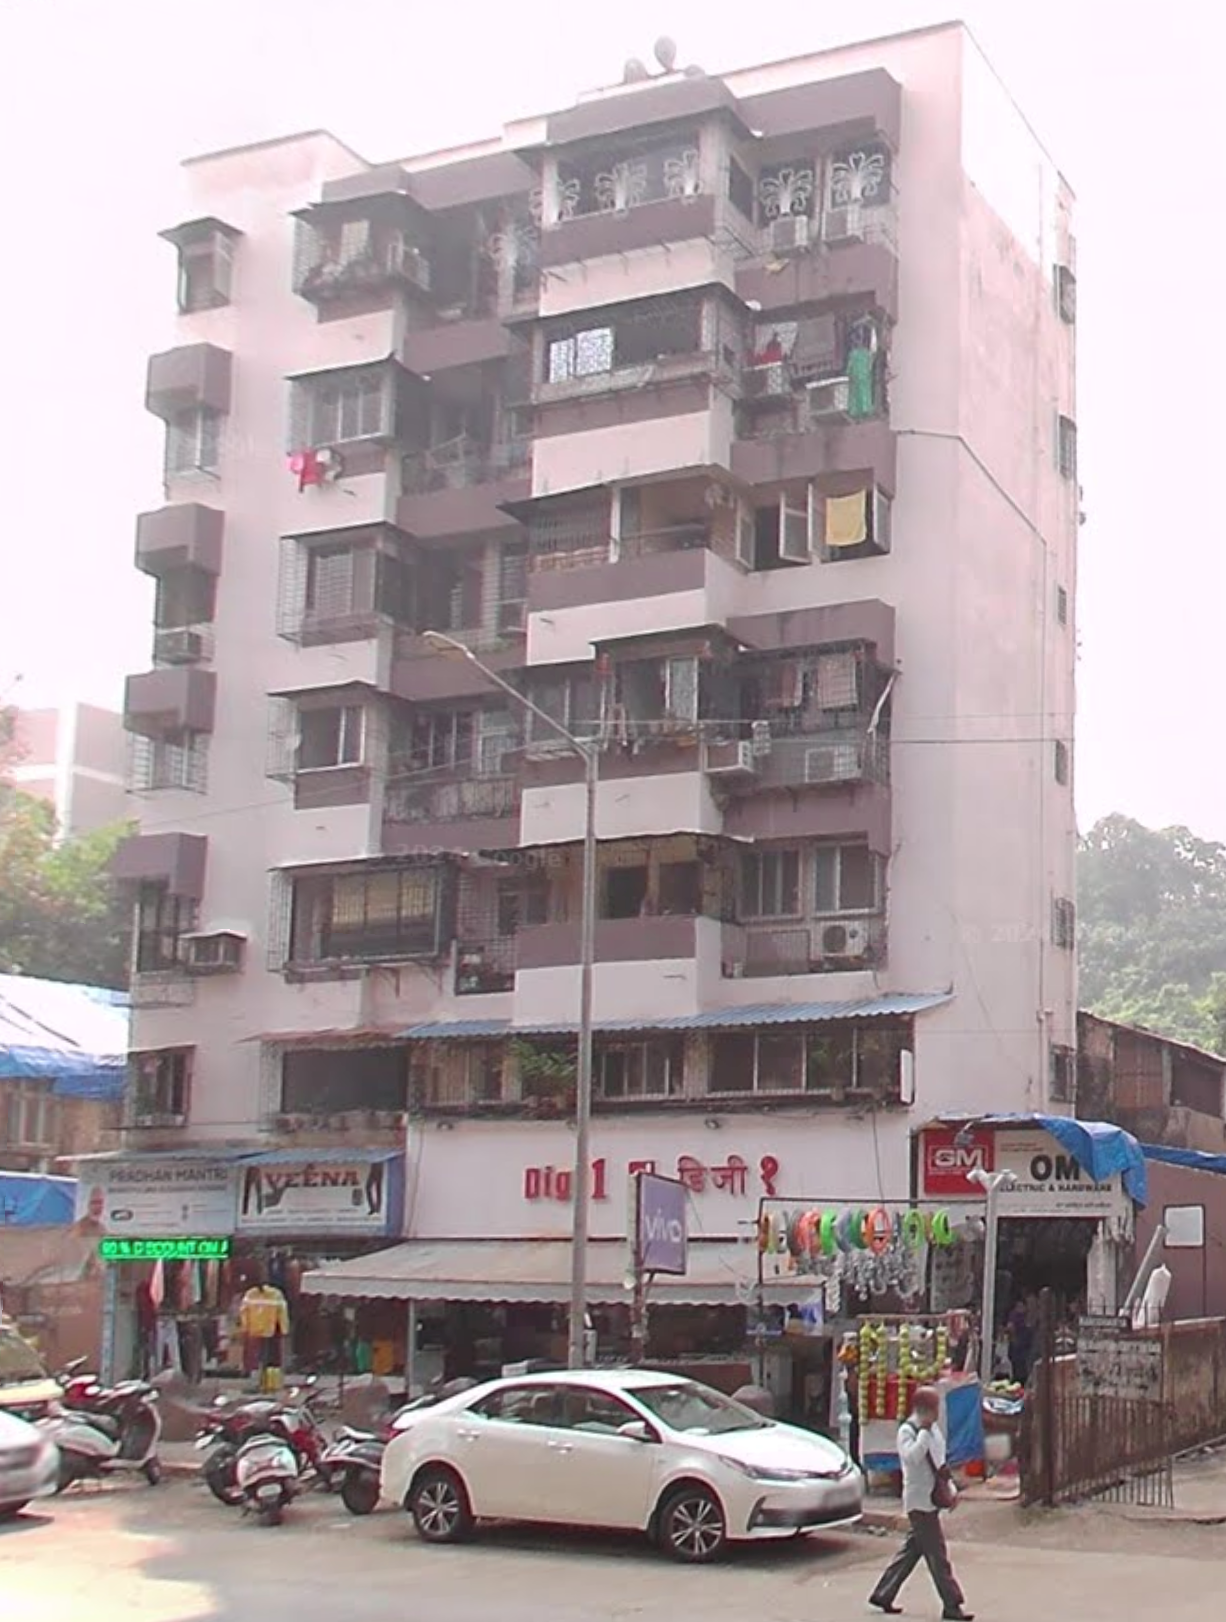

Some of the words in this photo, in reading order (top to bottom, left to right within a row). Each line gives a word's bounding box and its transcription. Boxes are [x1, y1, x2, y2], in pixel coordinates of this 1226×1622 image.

[109, 1168, 175, 1182] PRADHAN
[1030, 1154, 1081, 1181] OM
[644, 1208, 682, 1243] vivo
